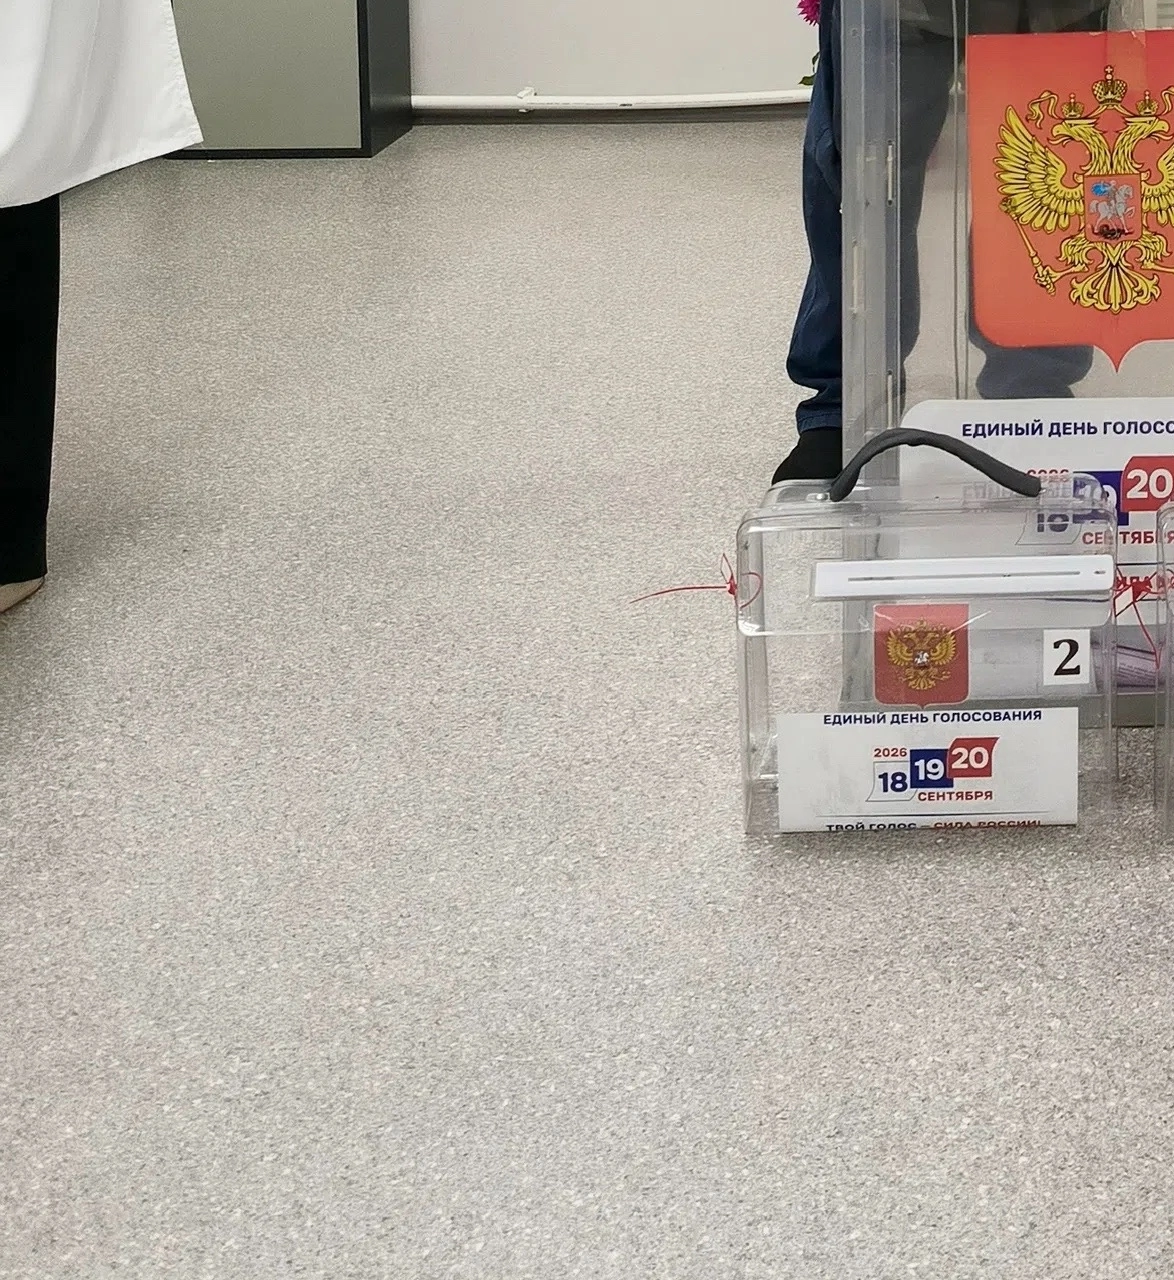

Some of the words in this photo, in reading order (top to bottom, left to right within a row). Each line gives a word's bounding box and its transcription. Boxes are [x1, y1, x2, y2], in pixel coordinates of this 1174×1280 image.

[962, 419, 1043, 438] ЕДИНЫЙ
[1048, 422, 1098, 437] ДЕНЬ
[1126, 468, 1173, 499] 20
[1053, 639, 1081, 676] 2
[824, 712, 886, 725] ЕДИНЫЙ
[890, 713, 928, 725] ДЕНЬ
[933, 711, 1042, 722] ГОЛОСОВАНИЯ
[874, 748, 907, 757] 2026
[878, 772, 908, 793] 18
[914, 758, 944, 780] 19
[951, 747, 989, 768] 20
[918, 790, 992, 801] СЕНТЯБРЯ
